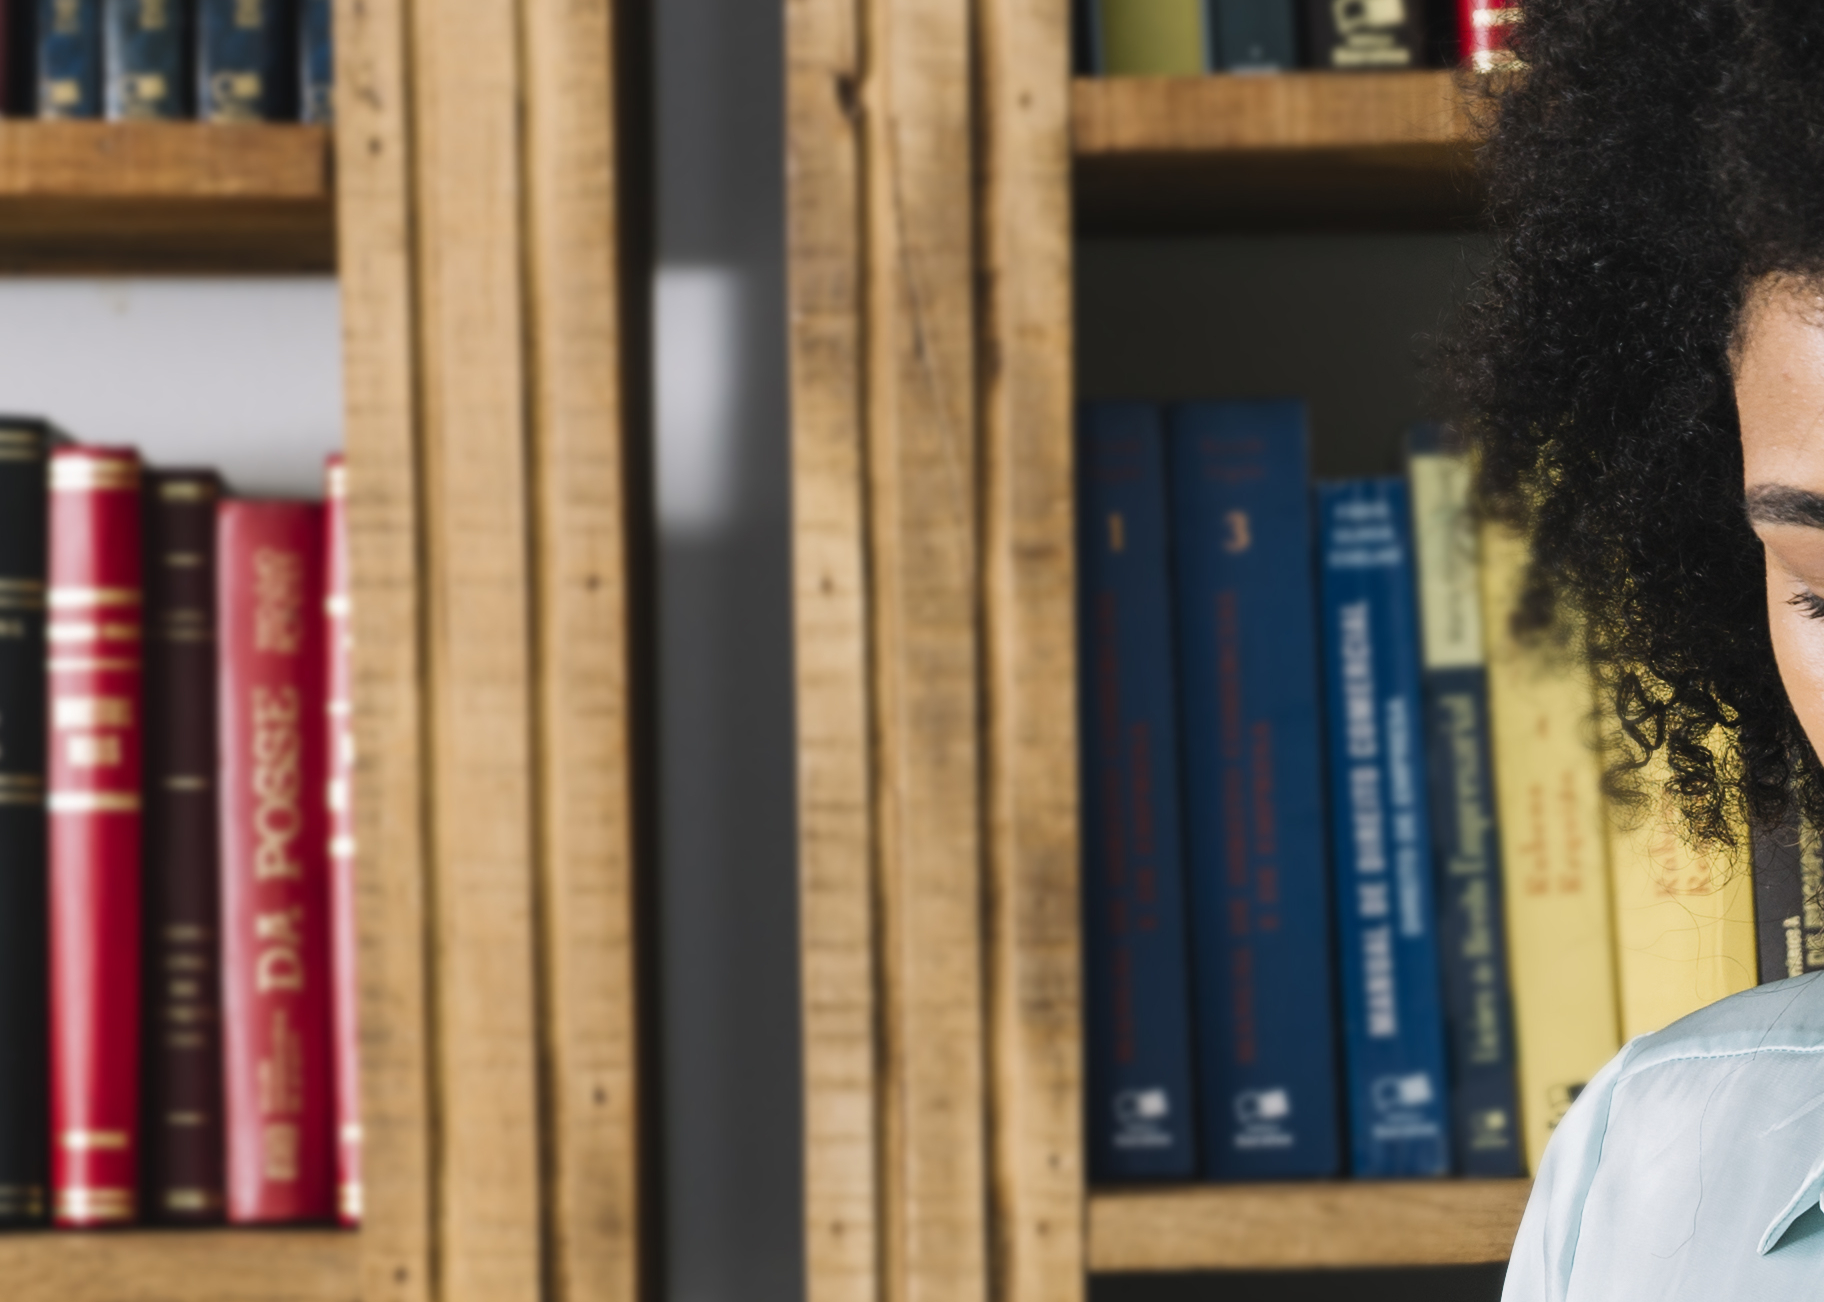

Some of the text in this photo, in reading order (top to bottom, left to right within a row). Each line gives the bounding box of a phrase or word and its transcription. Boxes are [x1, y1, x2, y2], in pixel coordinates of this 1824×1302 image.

[1223, 511, 1251, 553] 3
[253, 685, 301, 879] POSSE
[1340, 598, 1397, 1037] MANUAL DE DIREITO COMERCIAL
[255, 908, 303, 992] DA
